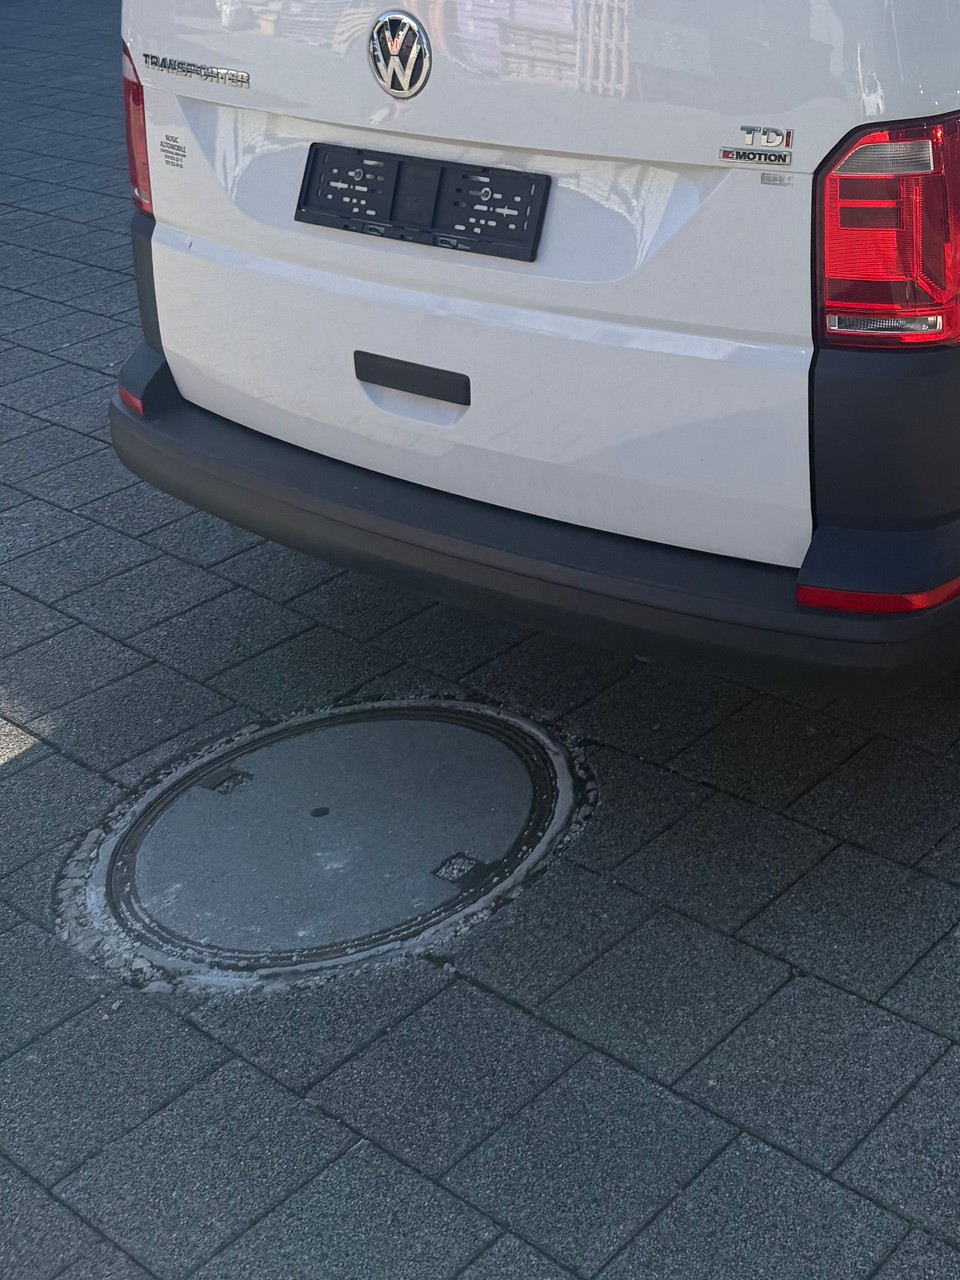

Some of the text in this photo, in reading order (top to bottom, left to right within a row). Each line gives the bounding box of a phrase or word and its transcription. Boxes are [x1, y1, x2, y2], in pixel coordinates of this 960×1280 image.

[142, 52, 251, 89] TRANSPORTER
[739, 124, 795, 149] TDI
[160, 140, 187, 154] AUTOMOBILE
[728, 150, 787, 163] 4MOTION
